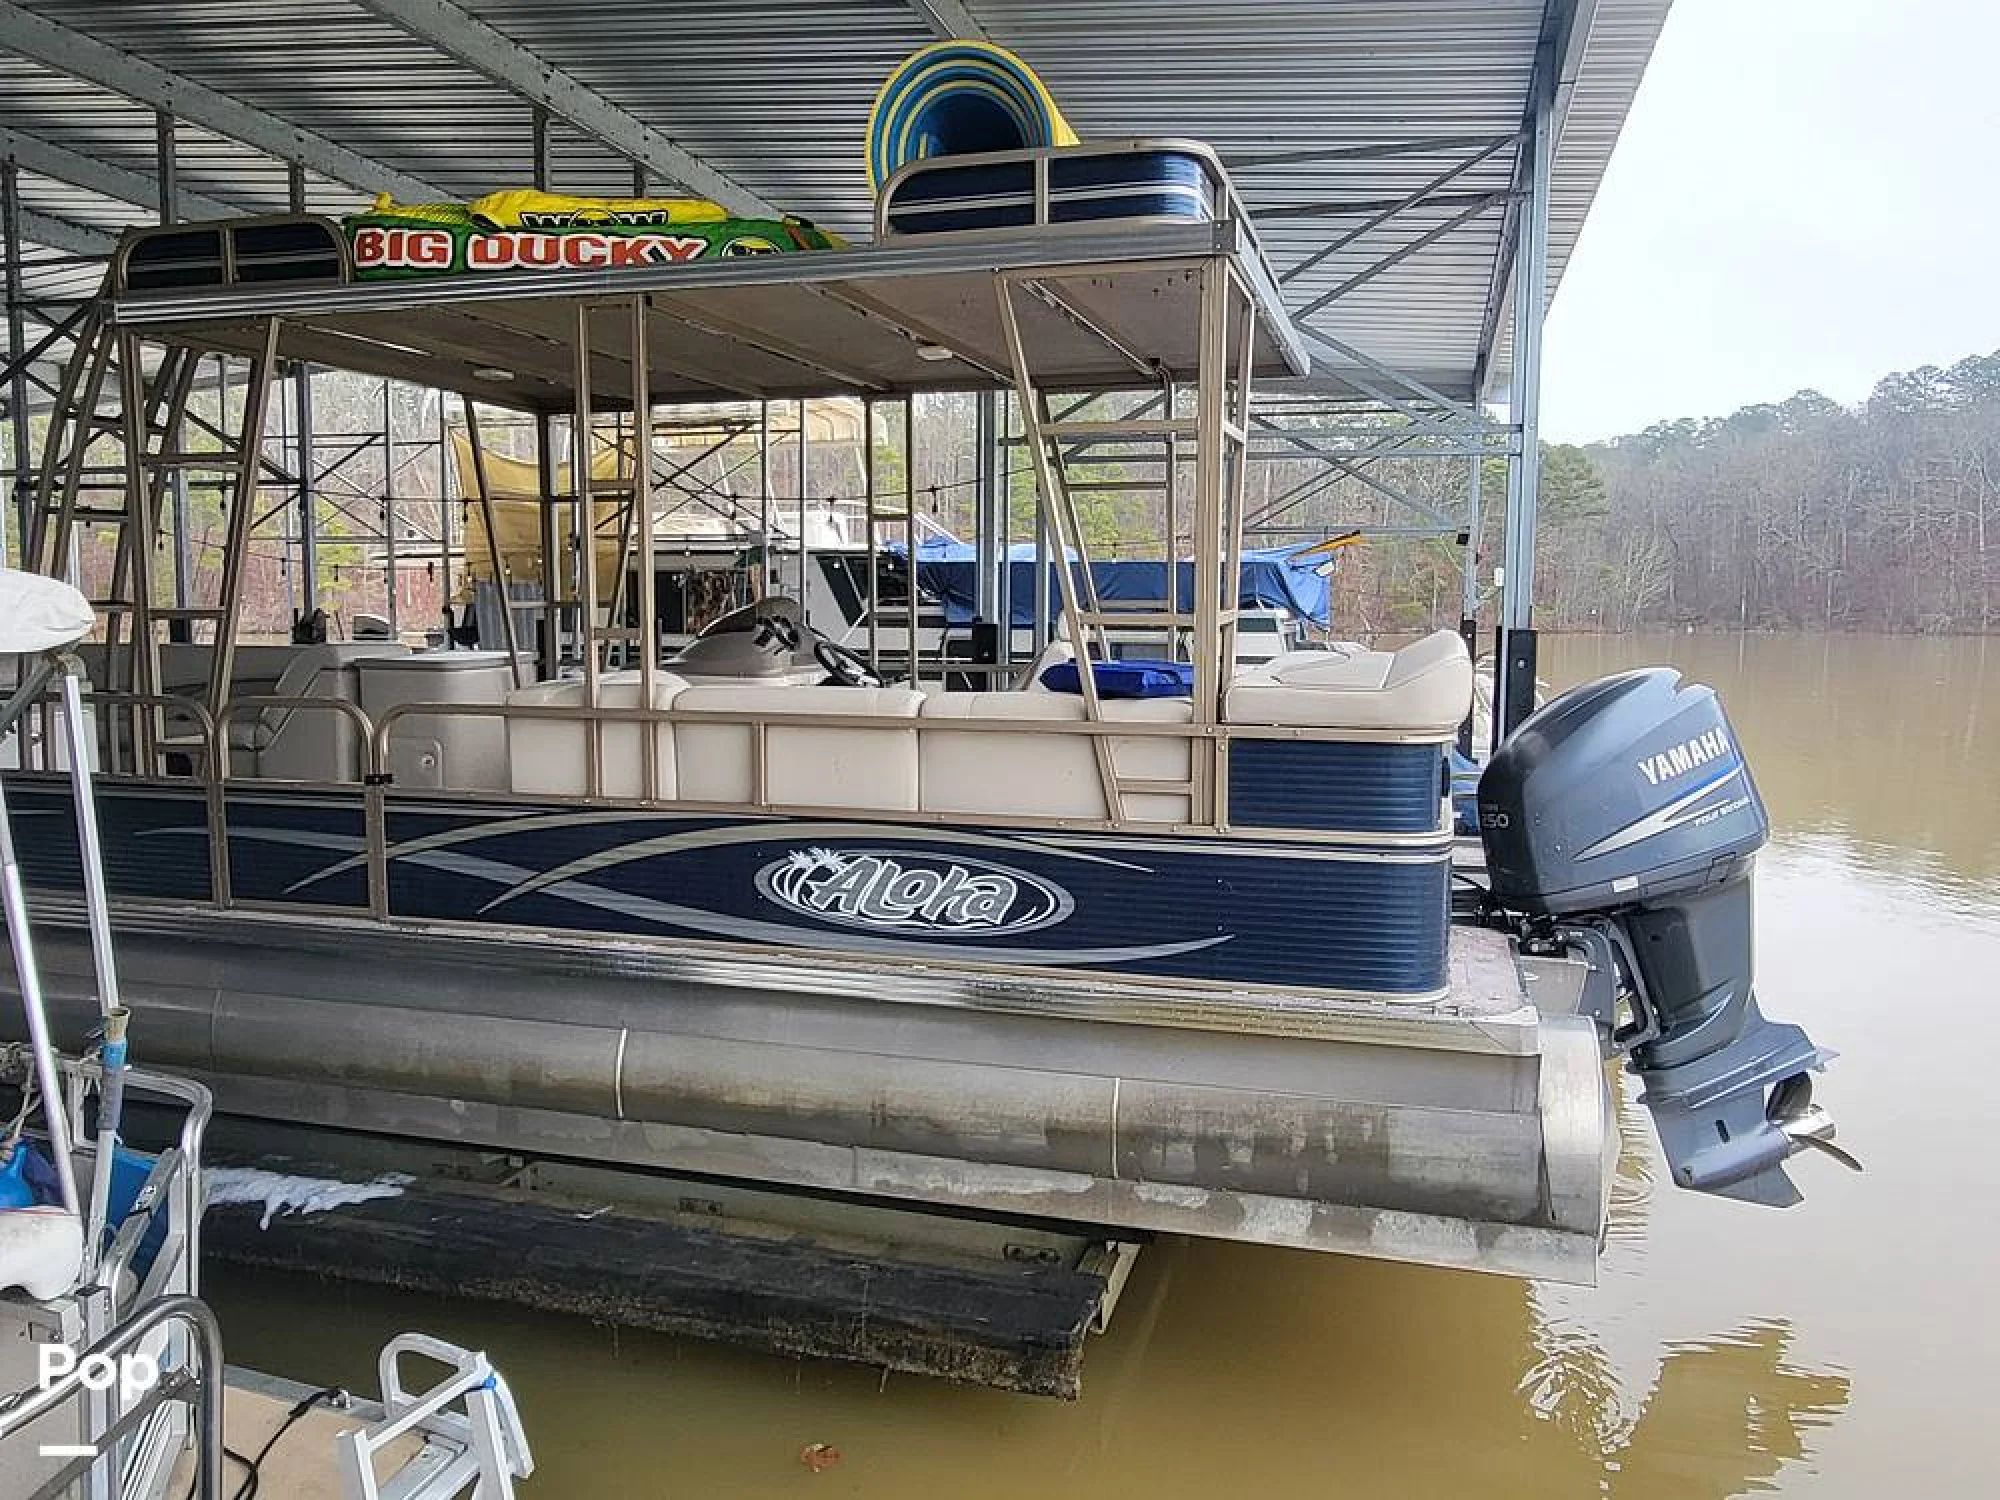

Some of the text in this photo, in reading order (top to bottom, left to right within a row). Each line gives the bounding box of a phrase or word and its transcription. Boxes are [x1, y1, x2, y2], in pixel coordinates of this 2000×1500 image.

[354, 228, 708, 270] BIG DUCKY
[1638, 728, 1731, 785] YAMAHA
